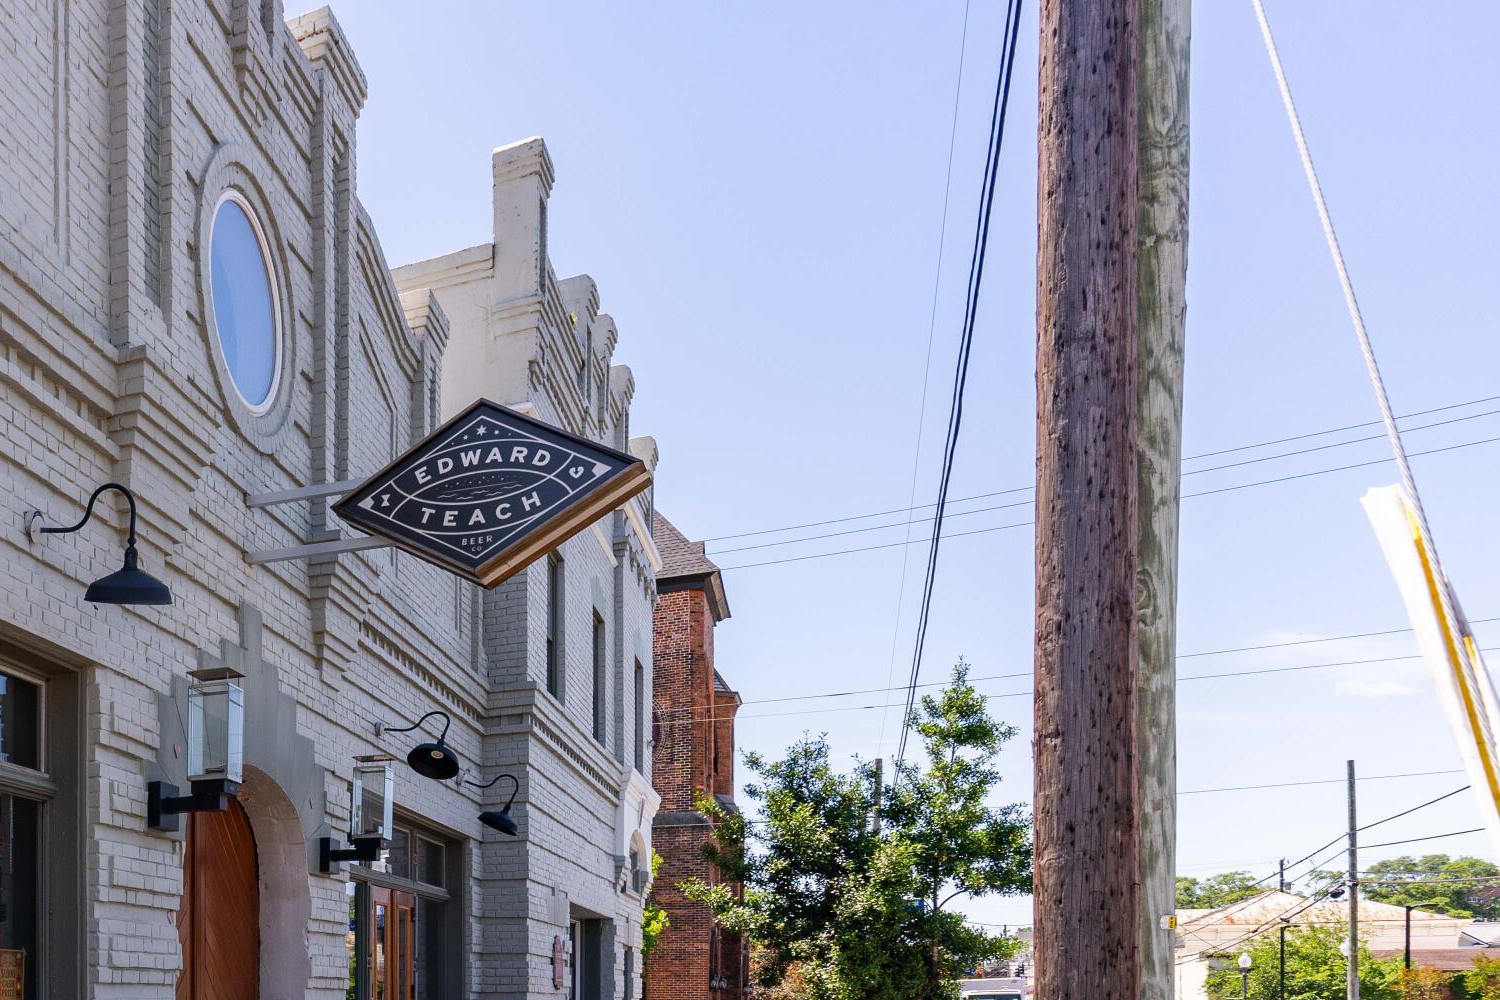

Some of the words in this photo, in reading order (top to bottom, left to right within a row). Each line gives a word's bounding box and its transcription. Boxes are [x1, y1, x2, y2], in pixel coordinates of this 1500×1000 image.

[414, 446, 551, 485] EDWARD
[420, 491, 541, 527] TEACH
[461, 535, 493, 546] BEER
